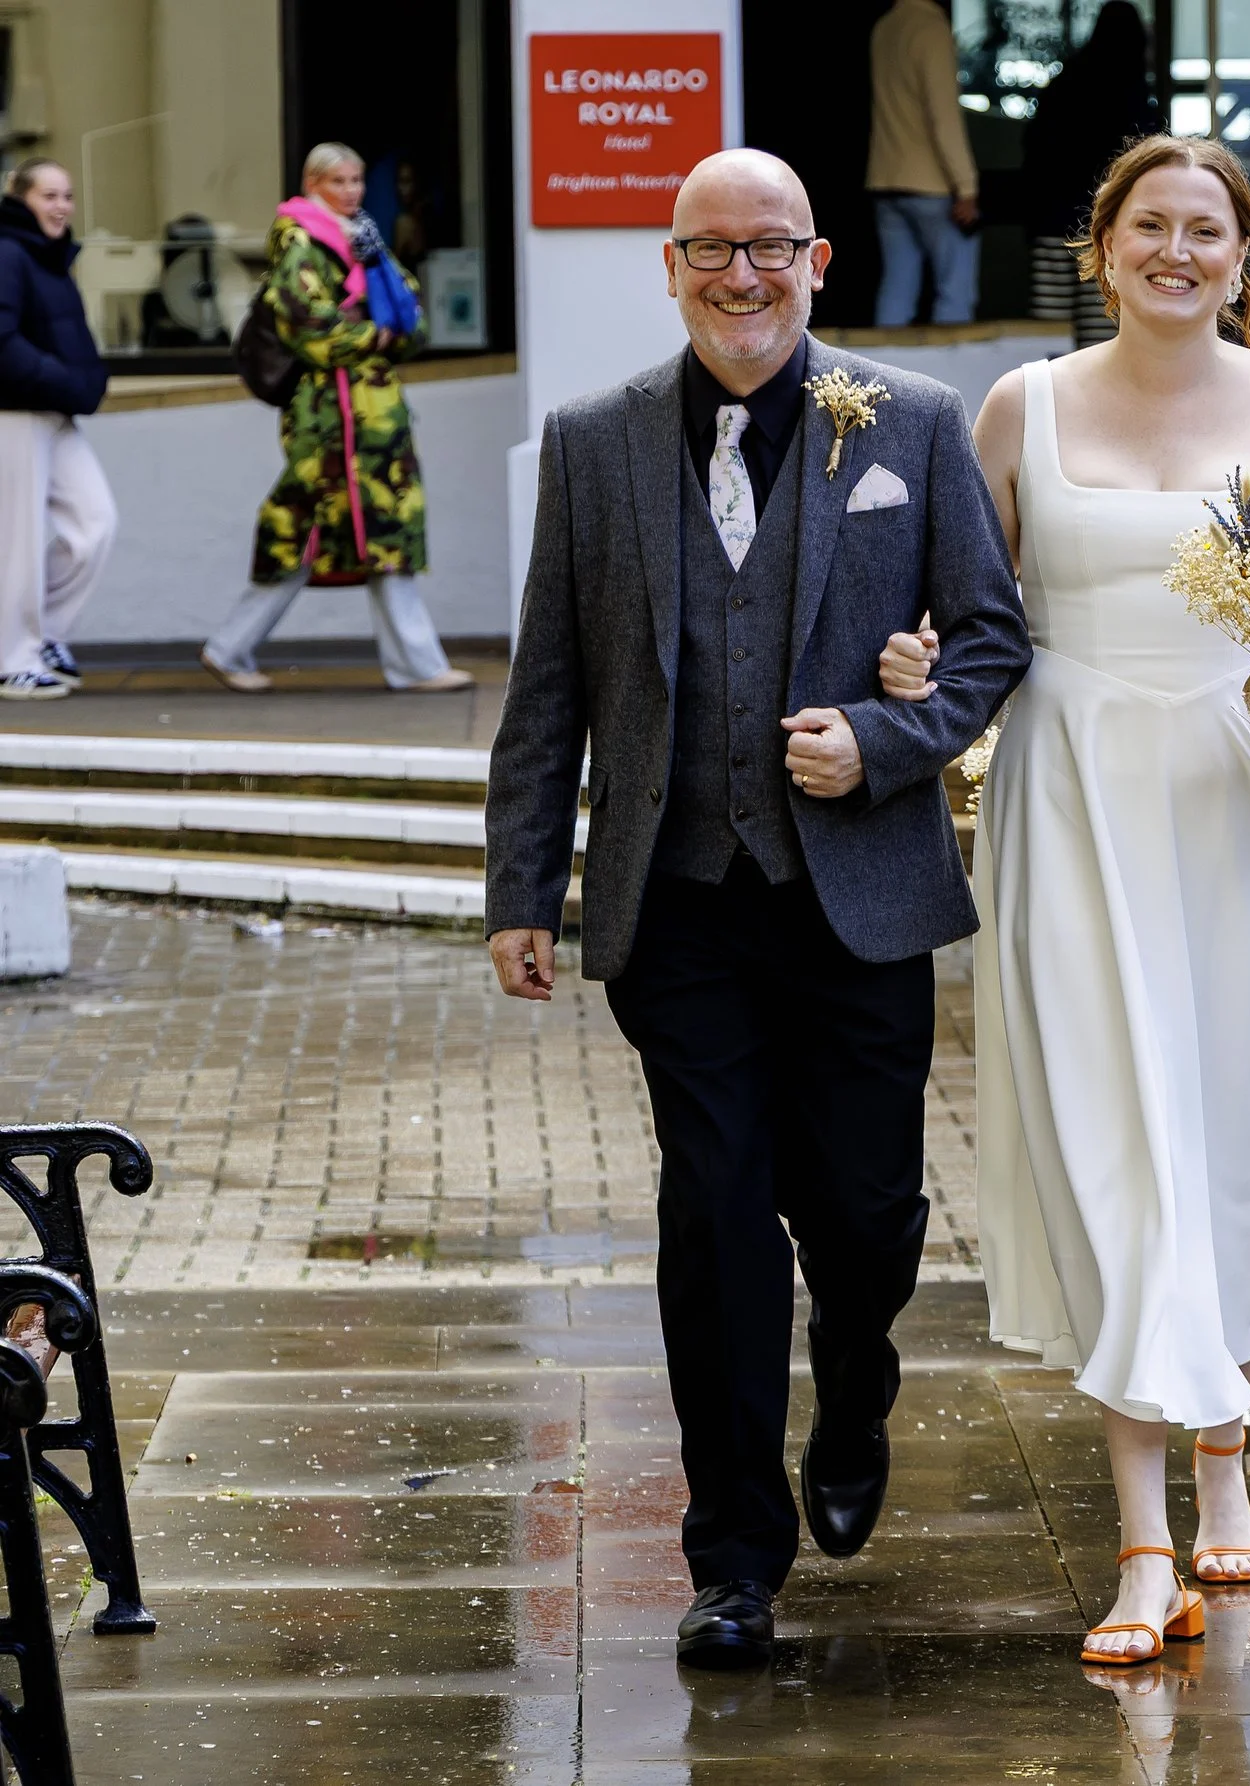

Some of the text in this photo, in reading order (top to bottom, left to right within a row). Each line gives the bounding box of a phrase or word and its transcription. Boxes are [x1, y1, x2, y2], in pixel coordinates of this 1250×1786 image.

[544, 69, 708, 93] LEONARDO
[578, 102, 673, 126] ROYAL
[604, 133, 651, 151] Hotel
